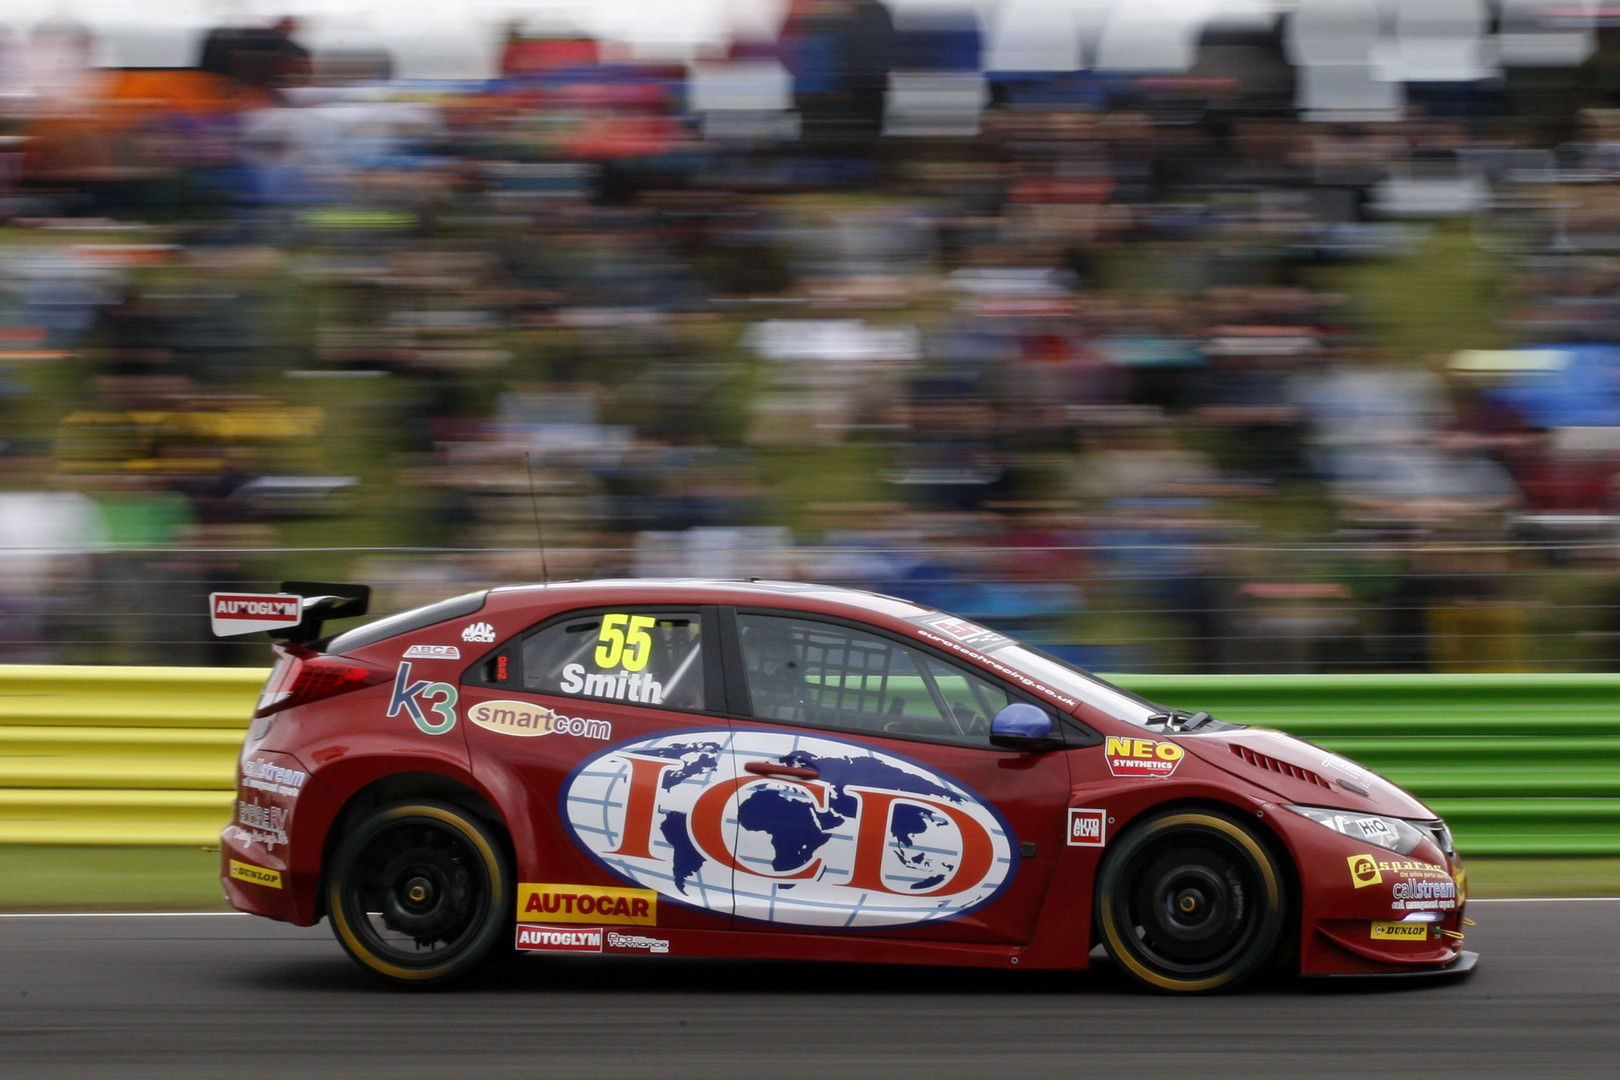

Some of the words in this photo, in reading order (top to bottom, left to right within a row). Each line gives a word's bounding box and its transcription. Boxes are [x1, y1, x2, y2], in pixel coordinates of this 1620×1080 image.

[216, 600, 297, 615] AUTOGLYM
[461, 622, 496, 638] MAC
[594, 613, 656, 672] 55
[917, 629, 1077, 707] eurotechracing.co.uk
[560, 663, 663, 704] Smith
[475, 706, 612, 740] smartcom
[1106, 738, 1183, 761] NEO
[1113, 759, 1173, 769] SYNTHETICS
[601, 755, 994, 897] ICD
[1074, 818, 1099, 829] AUTO
[1360, 820, 1388, 835] HiQ
[1073, 827, 1099, 837] GLYM
[238, 867, 279, 883] DUNLOP
[1392, 878, 1455, 900] callstream
[524, 892, 649, 917] AUTOCAR
[519, 930, 600, 946] AUTOGLYM
[1386, 926, 1425, 935] DUNLOP
